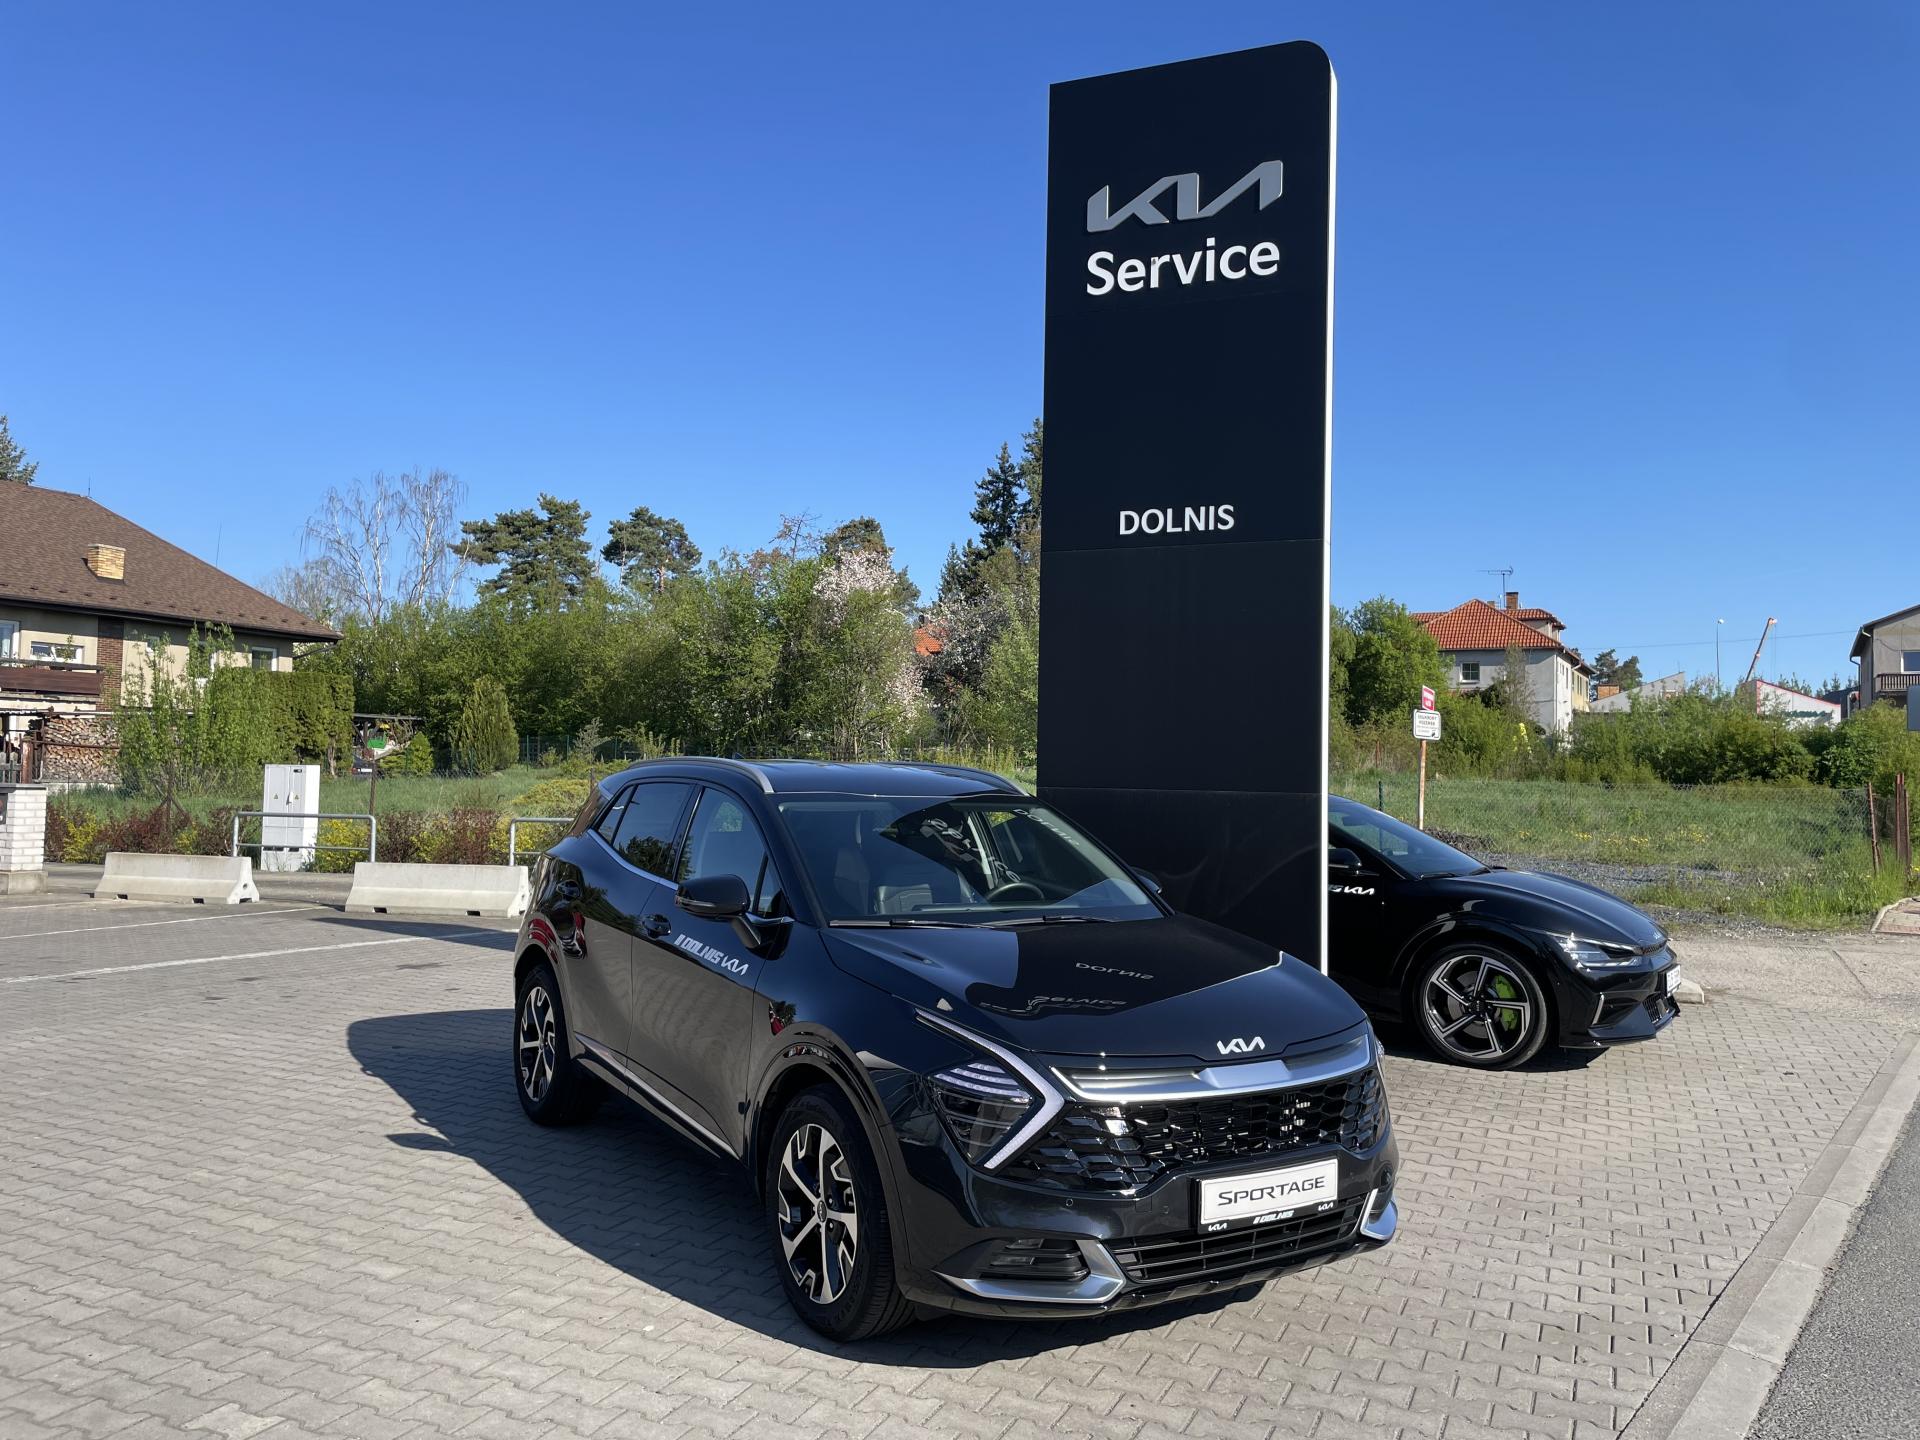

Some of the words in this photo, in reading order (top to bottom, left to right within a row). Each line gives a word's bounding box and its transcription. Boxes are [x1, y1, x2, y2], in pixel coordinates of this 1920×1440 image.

[1087, 237, 1280, 296] Service
[1119, 504, 1235, 535] DOLNIS
[1218, 1176, 1325, 1206] SPORTAGE
